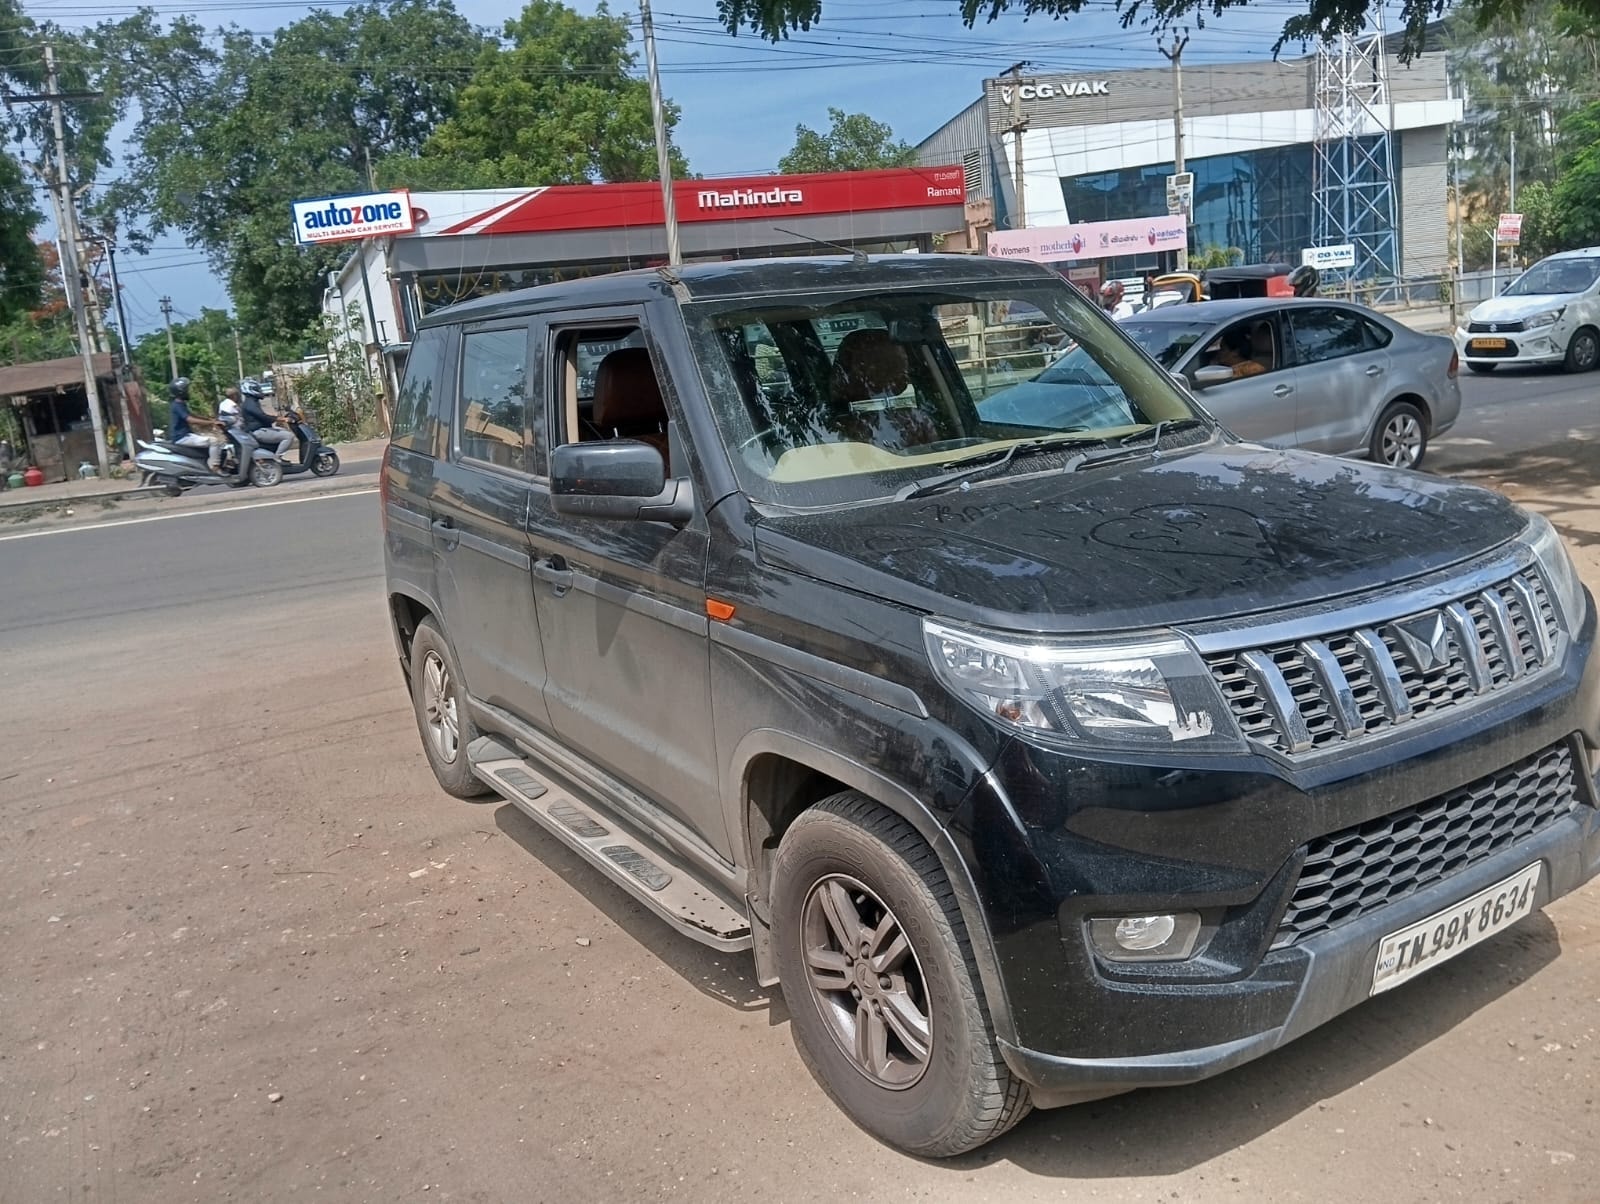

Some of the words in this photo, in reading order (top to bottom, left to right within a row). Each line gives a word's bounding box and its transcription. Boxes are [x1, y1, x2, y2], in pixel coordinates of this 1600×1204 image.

[1020, 81, 1109, 99] CG-VAK
[698, 187, 802, 208] Mahindra
[927, 186, 960, 197] Ramani
[304, 202, 402, 229] autozone
[307, 231, 330, 239] MULTI
[331, 228, 356, 236] BRAND
[358, 225, 373, 233] CAR
[374, 222, 404, 232] SERVICE
[1001, 246, 1030, 256] Womens
